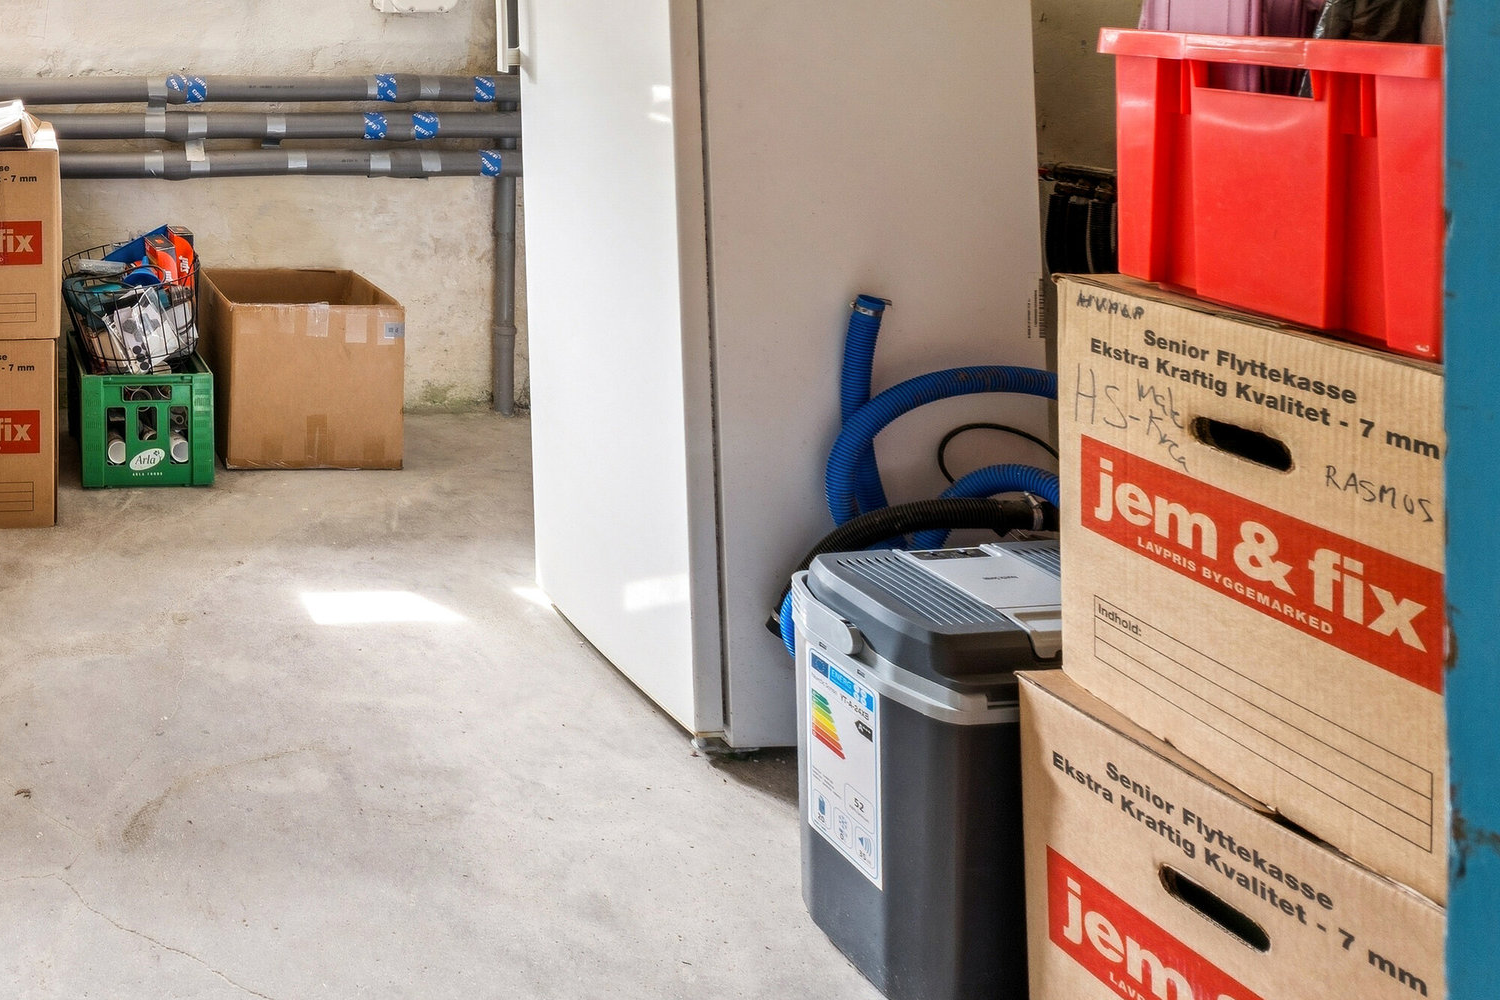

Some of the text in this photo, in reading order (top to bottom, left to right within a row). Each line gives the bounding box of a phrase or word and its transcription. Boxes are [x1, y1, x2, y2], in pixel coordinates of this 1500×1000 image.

[10, 174, 16, 182] 7
[8, 364, 14, 372] 7
[1090, 337, 1149, 370] Ekstra
[1156, 358, 1228, 398] Kraftig
[1236, 381, 1330, 427] Kvalitet
[1360, 418, 1375, 438] 7
[1386, 430, 1440, 460] mm
[1144, 329, 1357, 404] Senior Flyttekasse
[134, 454, 156, 465] Arla
[1324, 464, 1434, 523] RASMUS
[1094, 456, 1429, 654] jem & fix
[1137, 536, 1334, 636] LAVPRIS BYGGEMARKED
[1098, 603, 1142, 638] Indhold:
[1052, 750, 1114, 804] Ekstra
[1120, 794, 1196, 860] Kraftig
[1204, 847, 1307, 926] Kvalitet
[1338, 928, 1356, 952] 7
[1368, 949, 1428, 997] mm
[1106, 762, 1334, 910] Senior Flyttekasse
[1063, 876, 1193, 1000] jem
